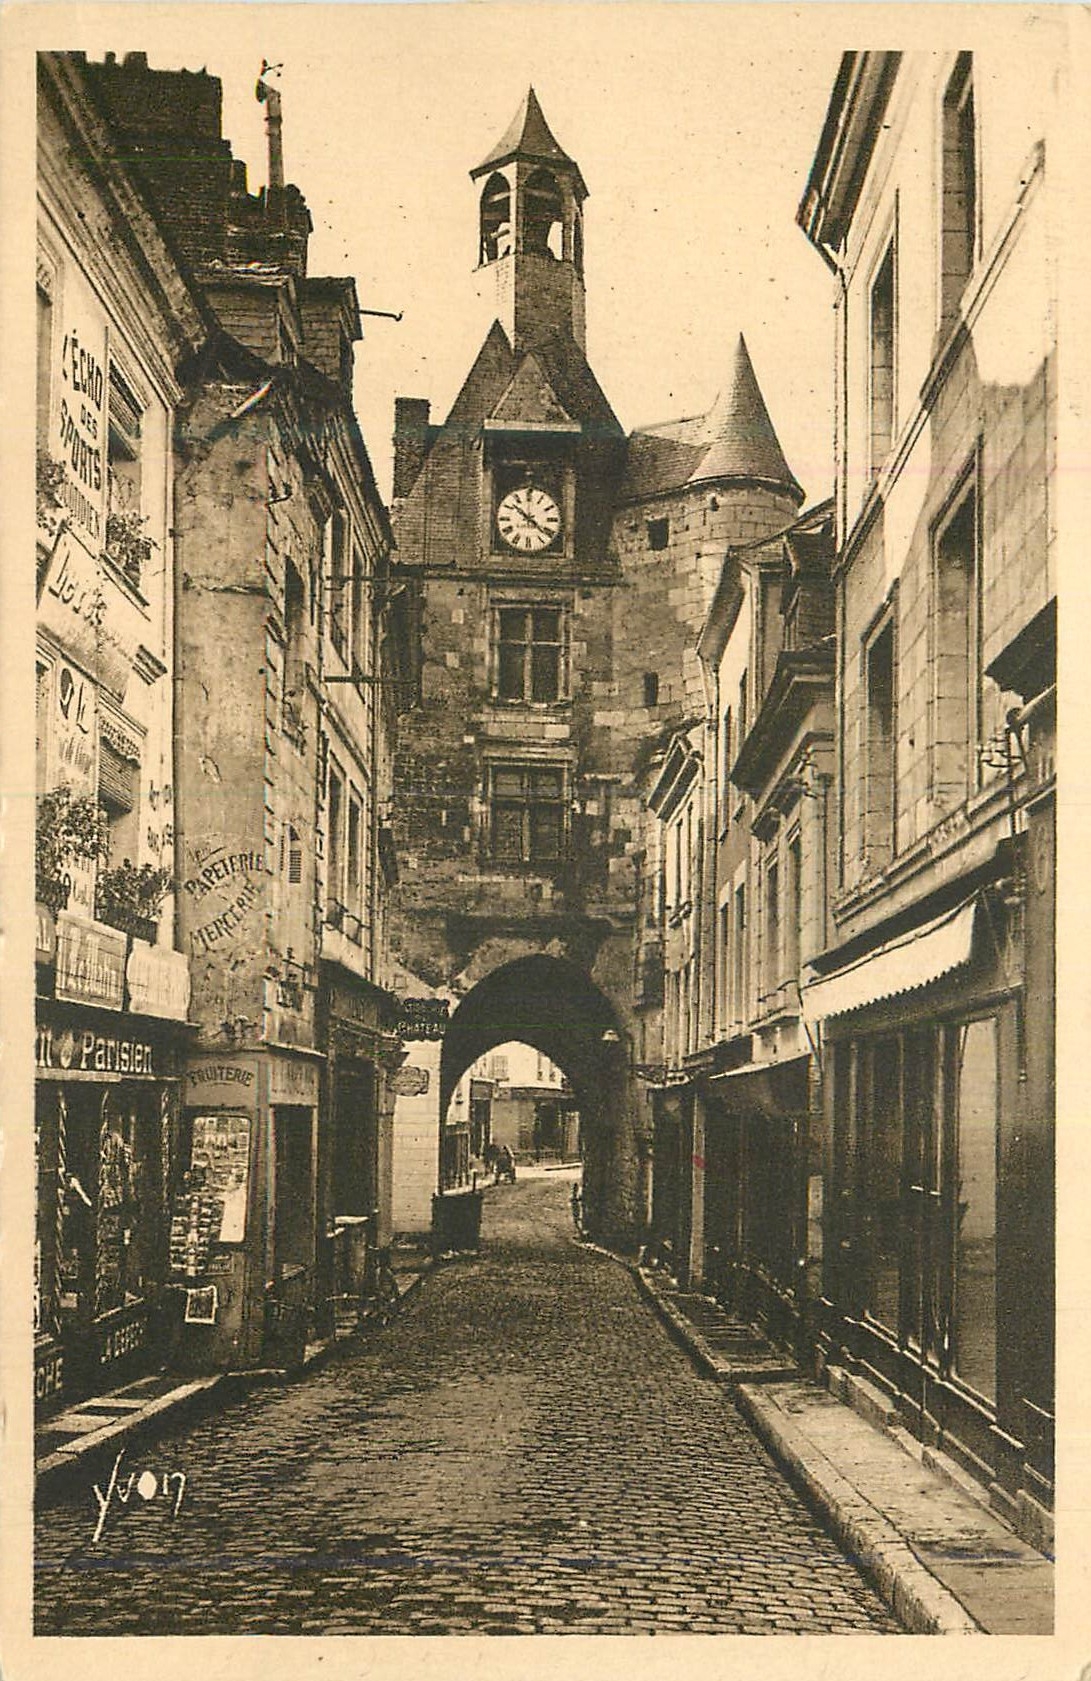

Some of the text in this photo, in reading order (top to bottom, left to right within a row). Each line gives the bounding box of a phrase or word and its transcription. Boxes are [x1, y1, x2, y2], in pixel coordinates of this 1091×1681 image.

[81, 403, 97, 439] DES
[60, 397, 100, 491] SPORTS
[184, 851, 263, 898] PAPETERIE
[80, 1030, 152, 1074] Parisien
[186, 1065, 254, 1087] FRUITERIE
